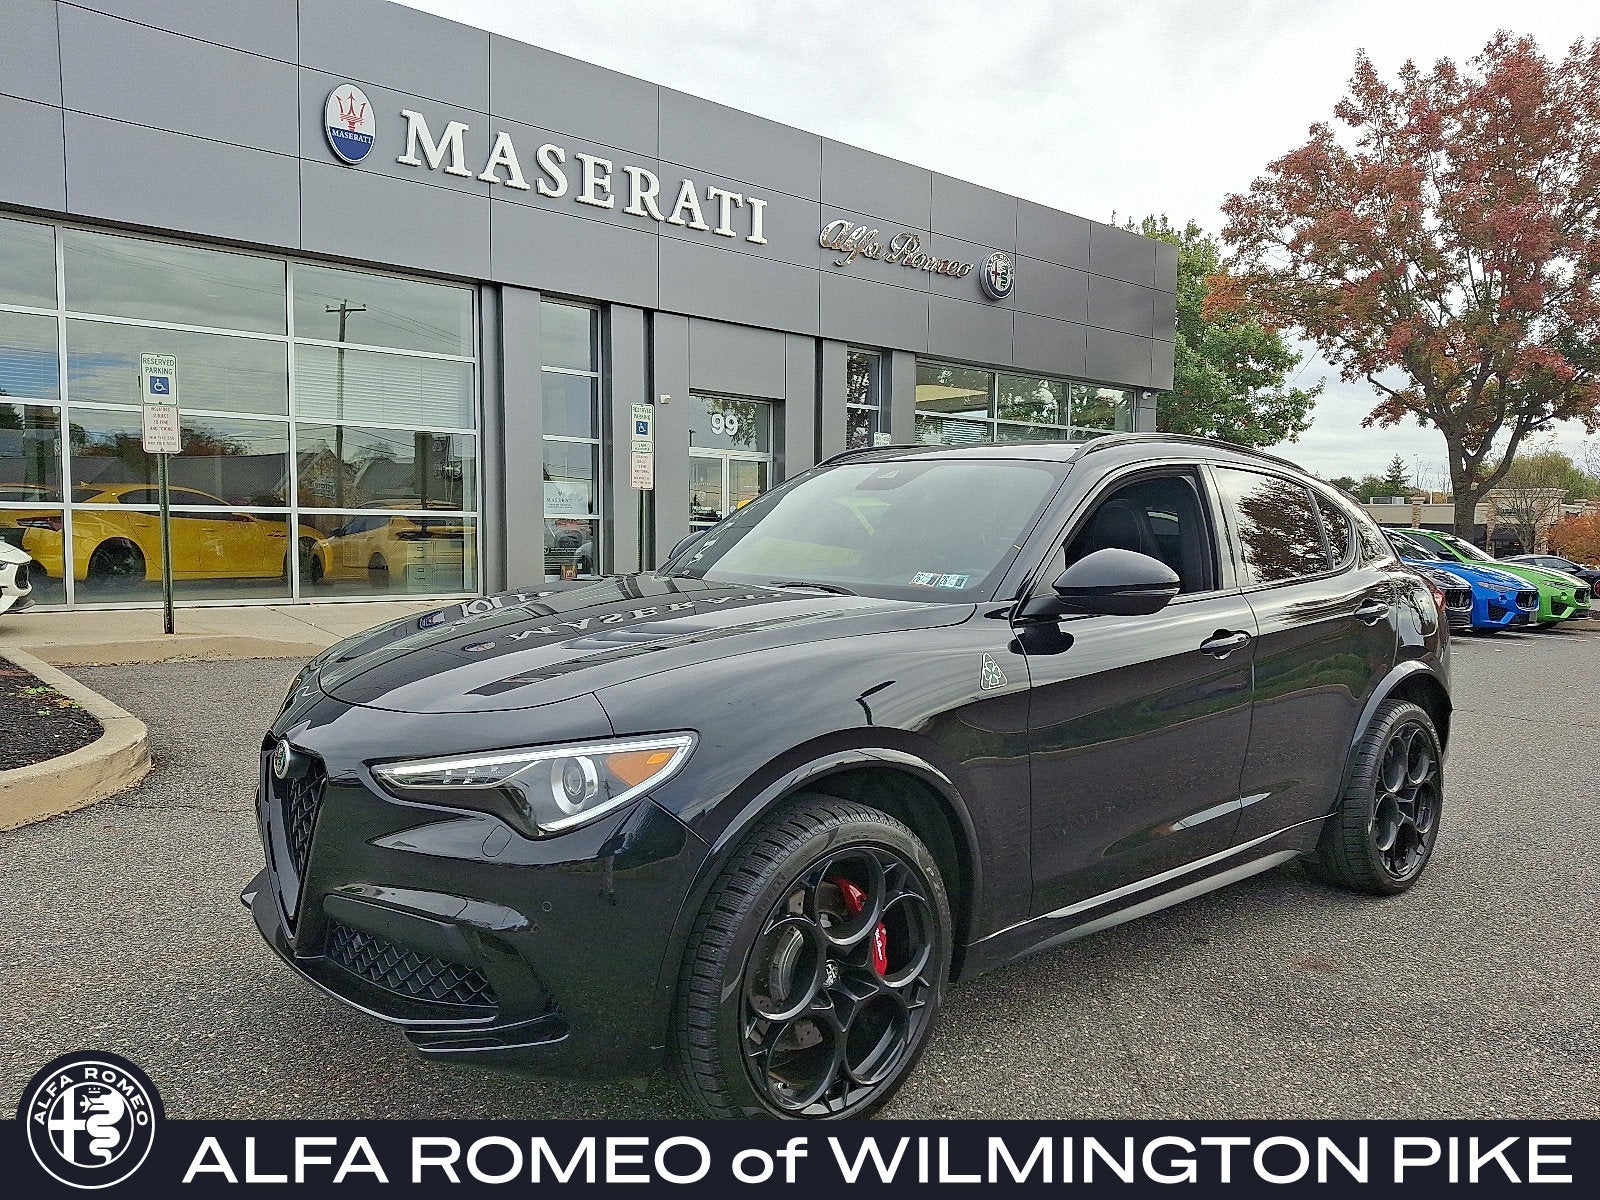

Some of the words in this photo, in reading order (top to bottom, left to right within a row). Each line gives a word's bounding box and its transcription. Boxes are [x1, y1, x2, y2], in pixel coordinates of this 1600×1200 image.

[331, 128, 372, 144] MASERATI
[396, 108, 768, 245] MASERATI
[819, 219, 880, 266] Alfa
[883, 231, 975, 278] Romeo
[142, 357, 175, 367] RESERVED
[145, 366, 173, 375] PARKING
[711, 413, 738, 436] 99
